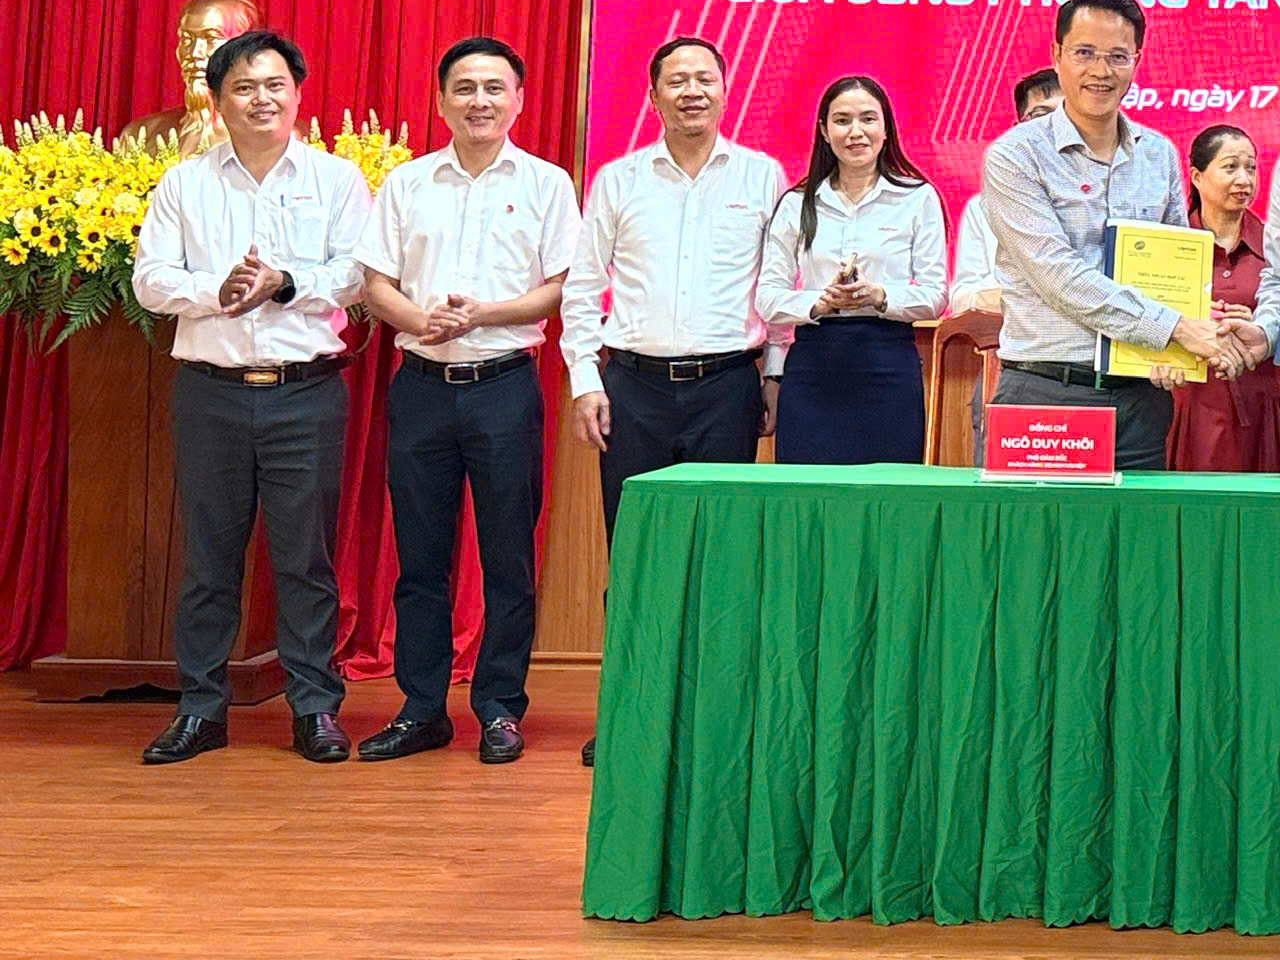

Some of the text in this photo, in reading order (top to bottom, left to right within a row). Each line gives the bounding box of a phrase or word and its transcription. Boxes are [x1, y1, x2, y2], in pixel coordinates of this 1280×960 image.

[1121, 84, 1164, 112] ập,
[1171, 84, 1244, 113] ngày
[1250, 85, 1279, 109] 17
[1001, 435, 1095, 451] NGÔ DUY KHÔI
